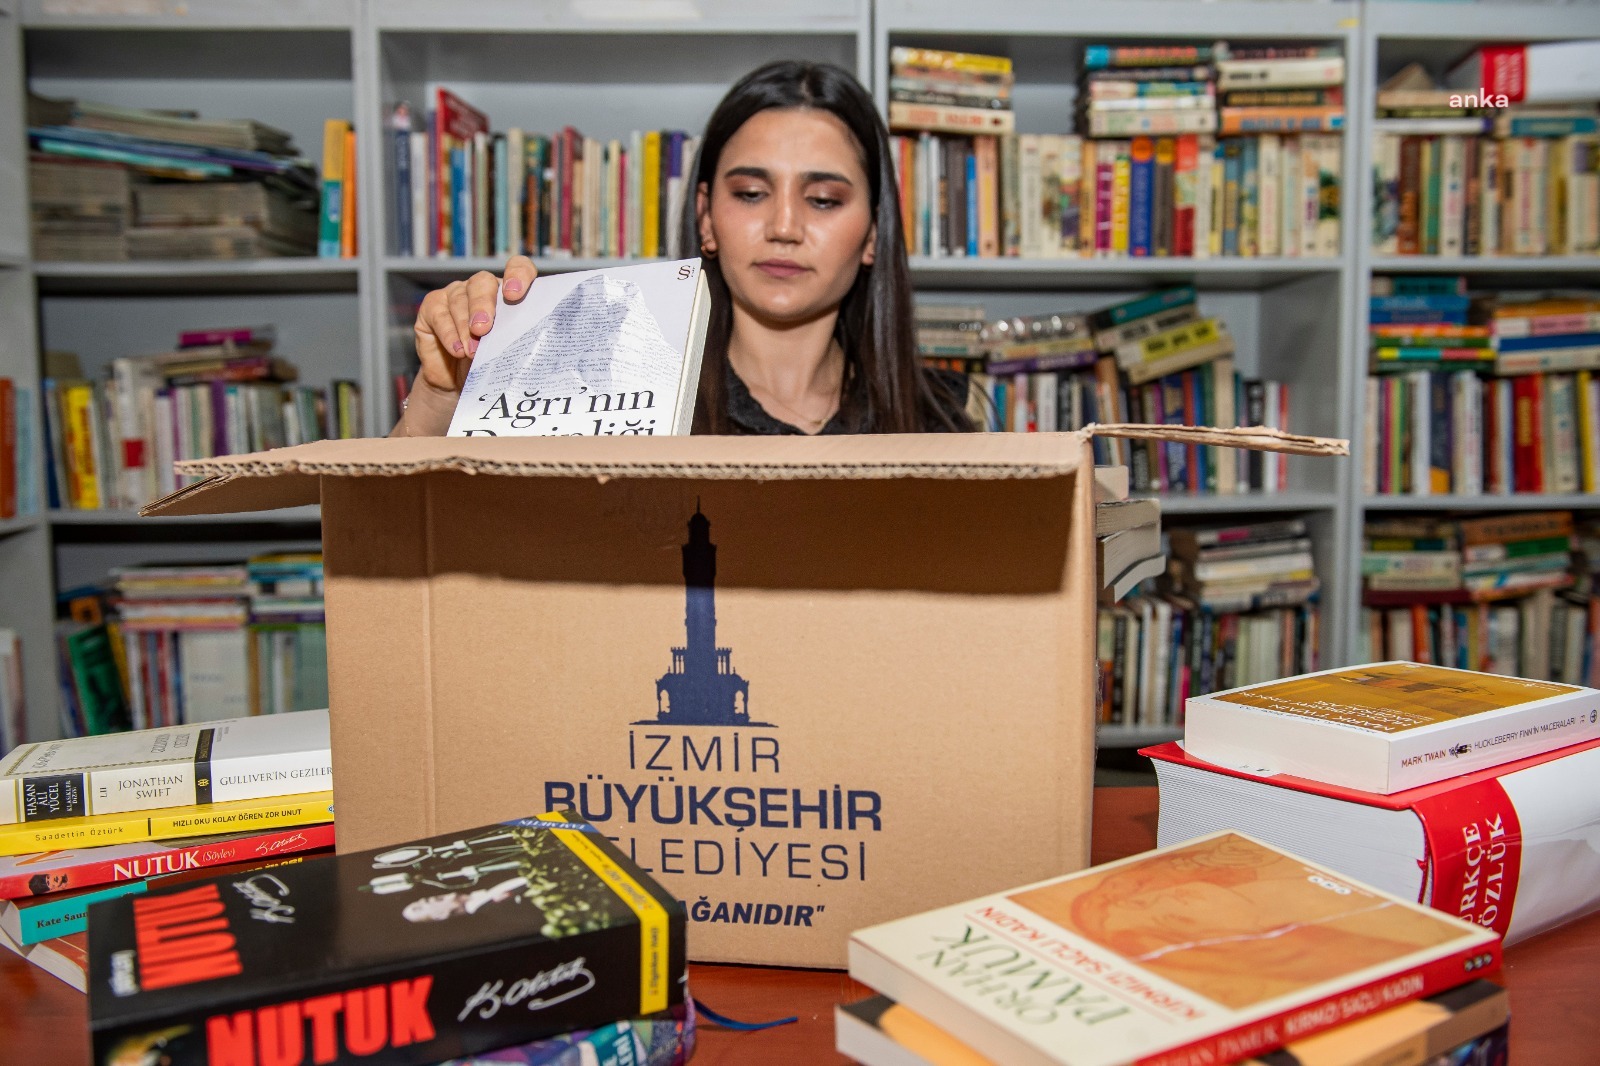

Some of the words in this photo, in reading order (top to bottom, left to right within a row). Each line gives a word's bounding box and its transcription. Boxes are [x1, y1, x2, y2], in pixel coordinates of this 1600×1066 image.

[629, 730, 780, 773] İZMİR
[1401, 753, 1423, 768] MARK
[1423, 750, 1447, 763] TWAIN
[1474, 732, 1519, 749] HUCKLEBERRY
[118, 774, 183, 791] JONATHAN
[290, 766, 333, 779] GEZİLER
[25, 784, 37, 816] HASAN
[136, 787, 172, 800] SWIFT
[544, 774, 882, 832] BÜYÜKŞEHİR
[35, 829, 86, 841] Saadettin
[90, 826, 124, 836] Öztürk
[172, 820, 192, 828] HIZLI
[194, 818, 211, 826] OKU
[212, 815, 237, 825] KOLAY
[238, 812, 264, 821] ÖĞREN
[265, 811, 280, 819] ZOR
[281, 809, 302, 817] UNUT
[113, 849, 201, 881] NUTUK
[605, 836, 866, 881] LEDİYESİ
[1460, 823, 1485, 924] RKÇE
[1478, 813, 1506, 931] ÖZLÜK
[37, 918, 62, 928] Kate
[931, 924, 1132, 1026] PAMUK
[205, 974, 436, 1066] NUTUK
